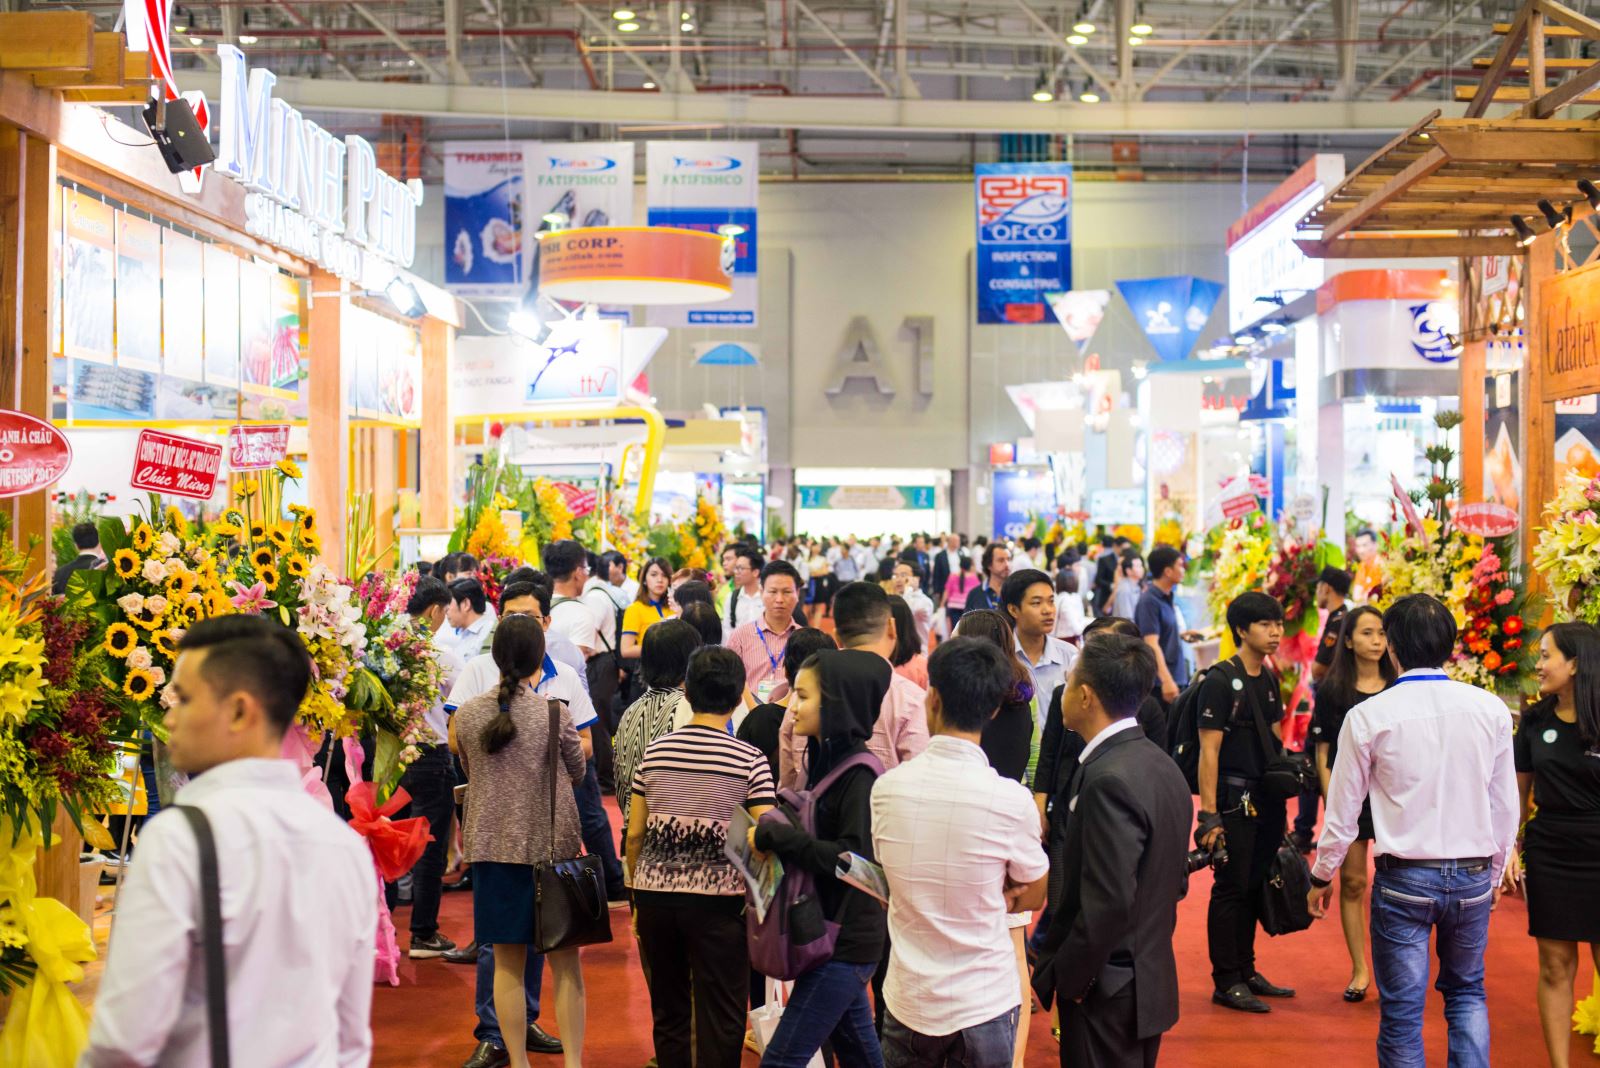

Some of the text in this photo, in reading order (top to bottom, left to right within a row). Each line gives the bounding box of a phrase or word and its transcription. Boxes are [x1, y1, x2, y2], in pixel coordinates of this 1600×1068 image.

[213, 43, 346, 234] MINH
[537, 175, 618, 186] FATIFISHCO
[663, 174, 743, 186] FATIFISHCO
[991, 224, 1058, 241] OFCO
[566, 237, 624, 250] CORP.
[991, 251, 1057, 262] INSPECTION
[1019, 265, 1030, 276] &
[989, 278, 1061, 290] CONSULTING
[824, 315, 935, 401] A1
[29, 427, 53, 445] CHÂU
[137, 466, 173, 486] Chúc
